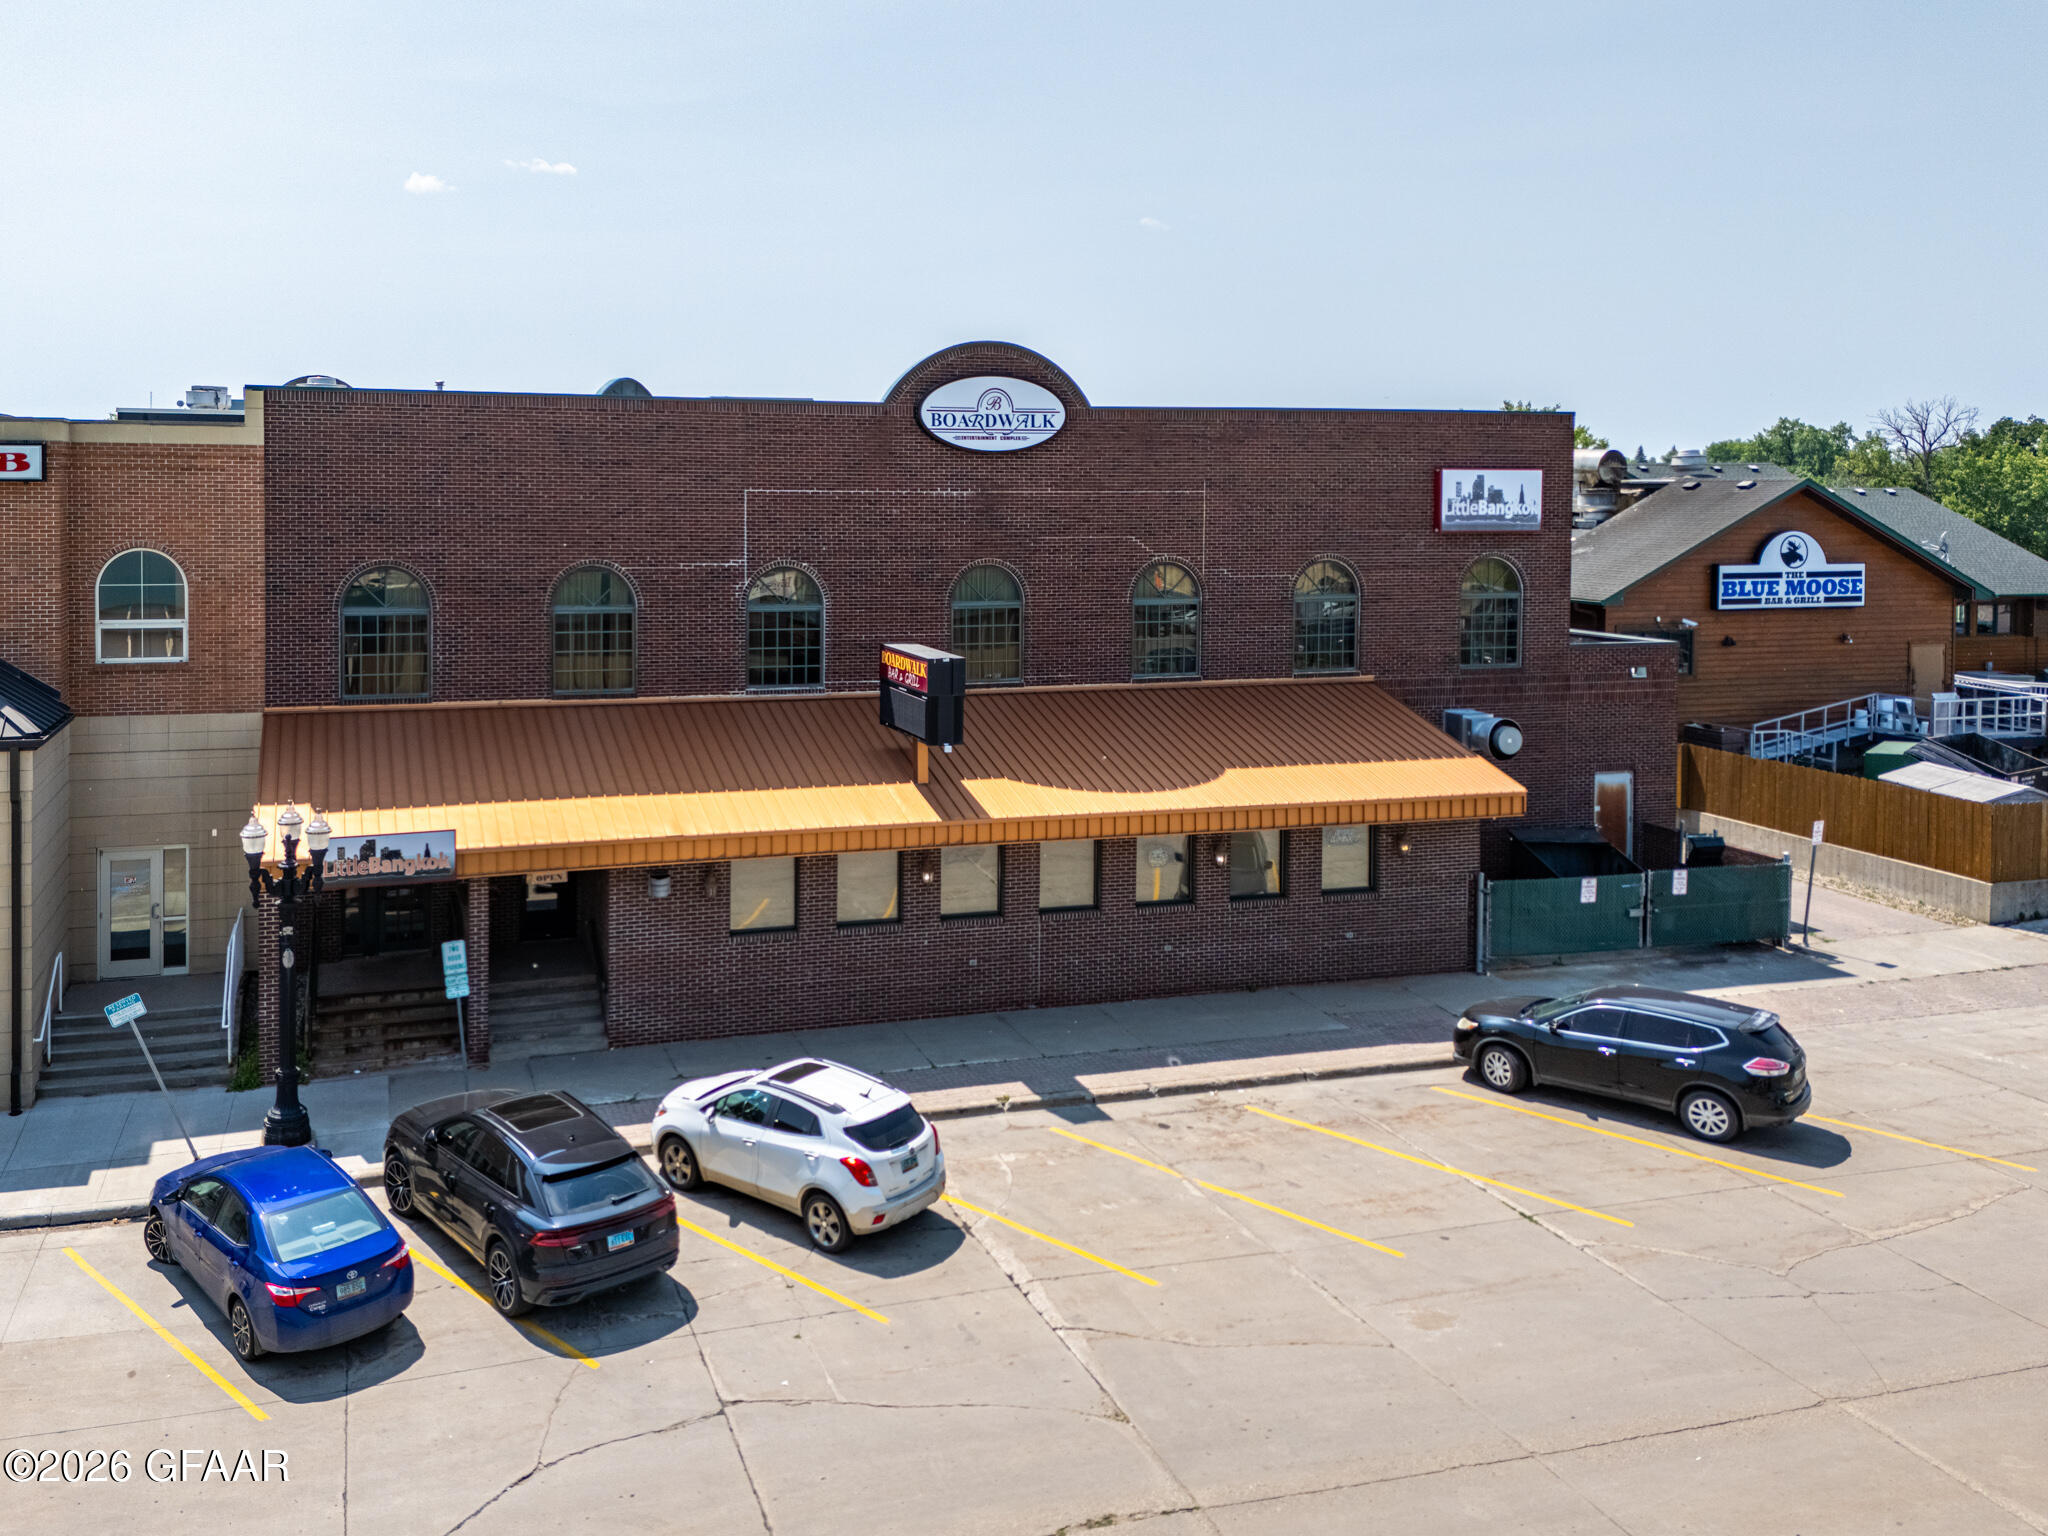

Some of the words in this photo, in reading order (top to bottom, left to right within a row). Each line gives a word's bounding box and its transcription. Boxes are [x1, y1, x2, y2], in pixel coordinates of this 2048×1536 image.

[931, 412, 1056, 435] BOARDWALK
[1445, 498, 1539, 519] LittleBangkok
[1784, 571, 1805, 579] THE
[1721, 580, 1780, 597] BLUE
[1784, 578, 1863, 596] MOOSE
[1764, 597, 1784, 605] BAR
[1793, 596, 1822, 604] GRILL
[881, 650, 927, 678] BOARDWALK
[888, 666, 898, 680] BAR
[904, 672, 920, 688] GRILL
[322, 851, 452, 877] LittleBangkok
[536, 873, 563, 881] OPEN
